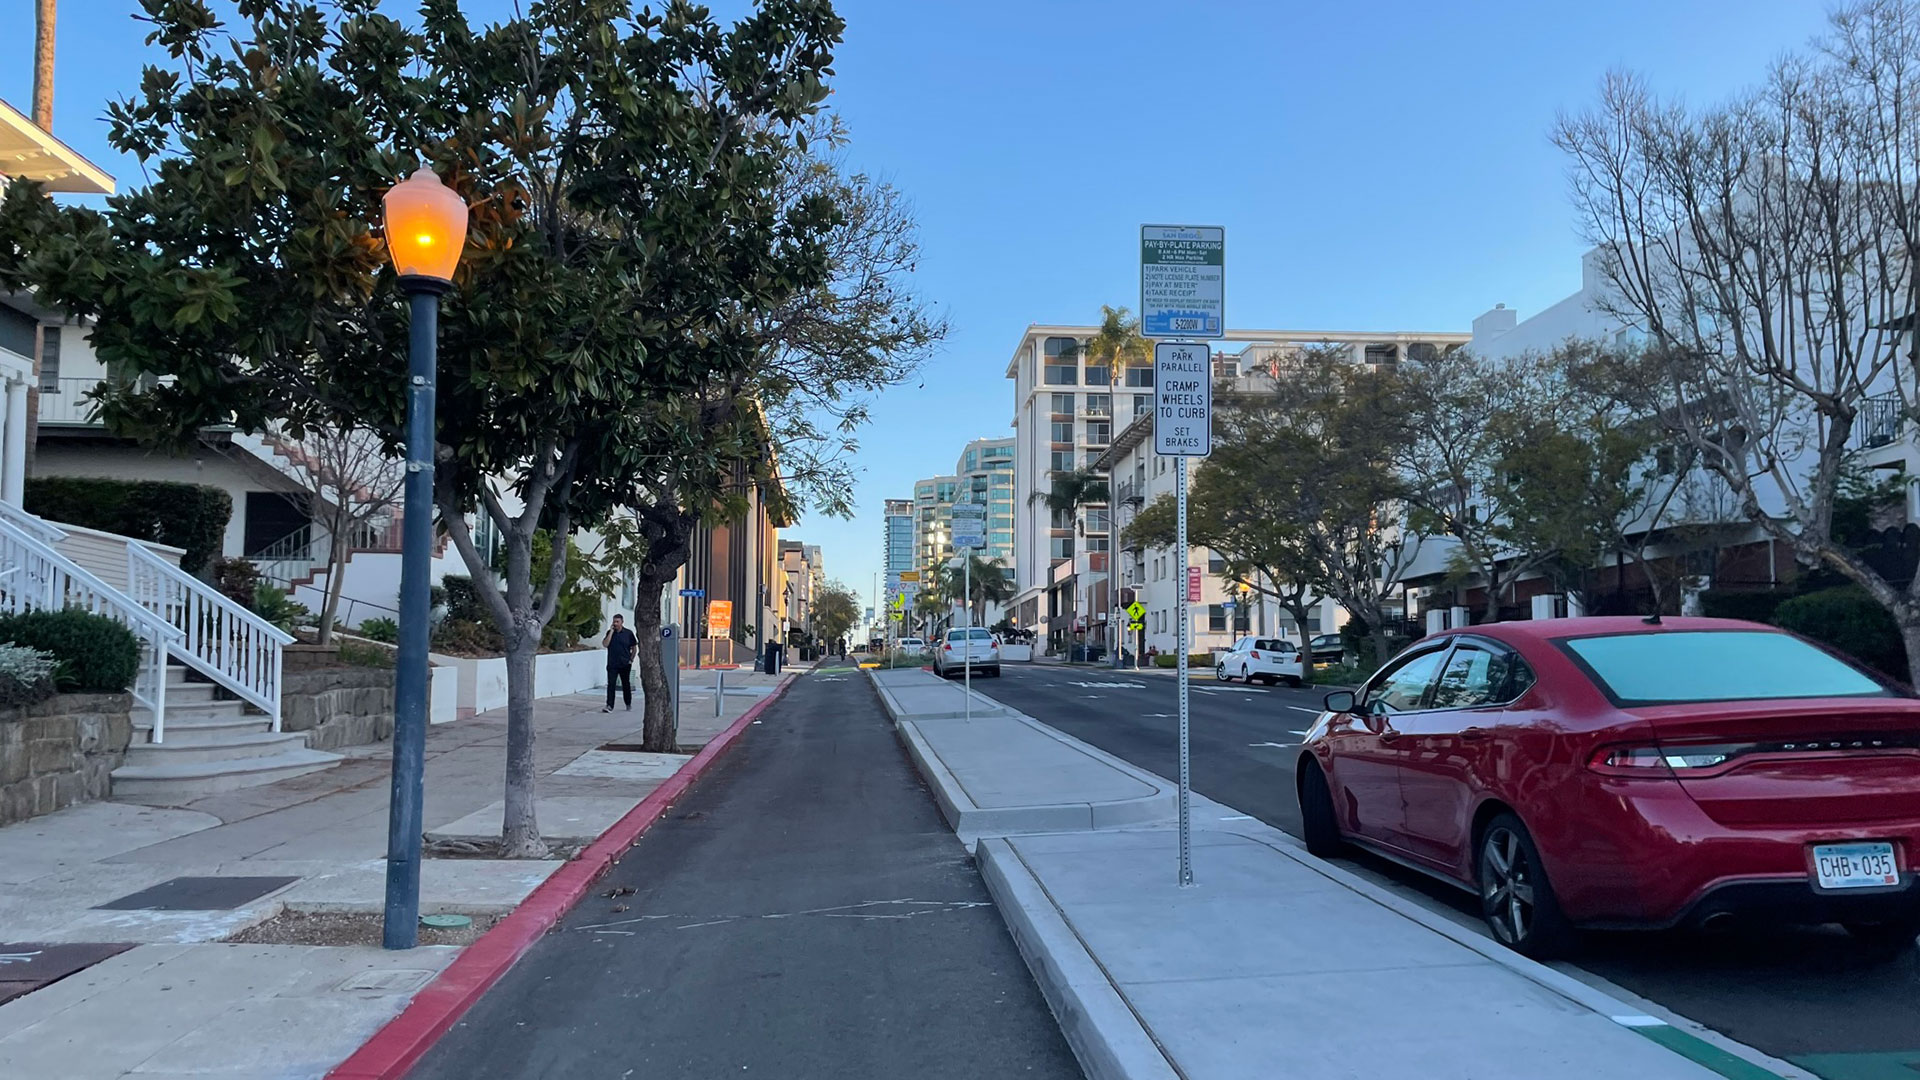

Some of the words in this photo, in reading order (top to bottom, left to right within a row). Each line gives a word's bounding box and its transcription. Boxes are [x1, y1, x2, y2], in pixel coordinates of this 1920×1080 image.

[1192, 242, 1222, 250] PARKING
[1172, 352, 1194, 361] PARK
[1161, 363, 1203, 372] PARALLEL
[1166, 381, 1200, 392] CRAMP
[1162, 394, 1203, 405] WHEELS
[1160, 407, 1172, 418] TO
[1178, 407, 1206, 419] CURB
[1174, 427, 1190, 436] SET
[1166, 438, 1199, 447] BRAKES
[1784, 740, 1882, 750] DODGE
[1820, 856, 1852, 878] CHB
[1861, 854, 1892, 876] 035
